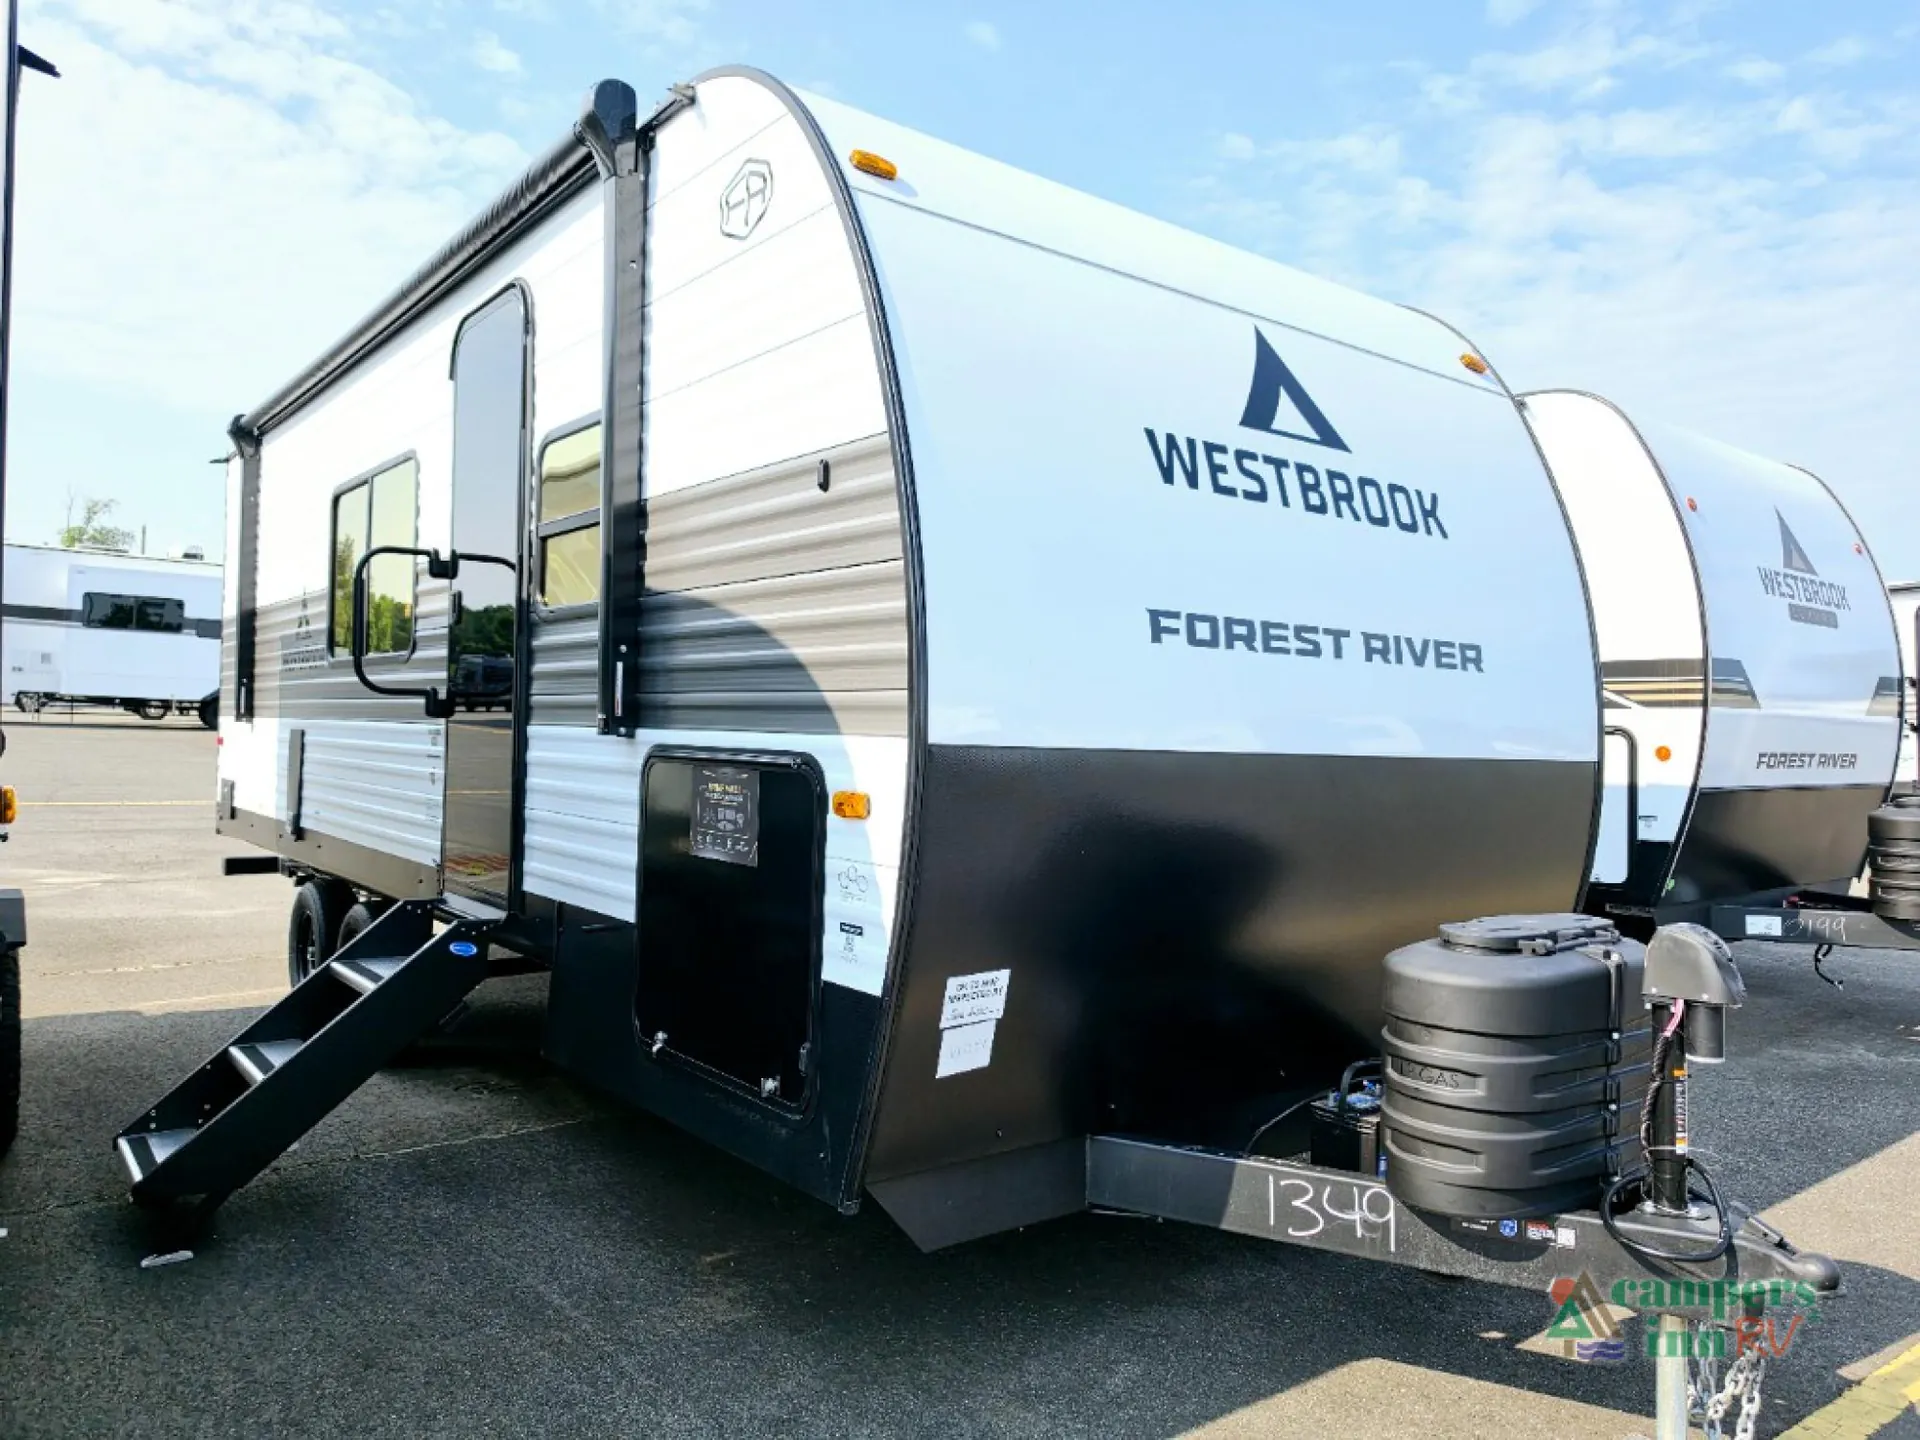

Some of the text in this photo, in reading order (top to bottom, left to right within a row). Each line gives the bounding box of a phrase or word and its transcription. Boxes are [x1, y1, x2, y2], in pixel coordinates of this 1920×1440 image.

[1144, 427, 1449, 539] WESTBROOK
[1757, 565, 1852, 612] WESTBROOK
[1145, 607, 1485, 674] FOREST RIVER
[1756, 752, 1857, 770] FOREST RIVER
[1418, 1065, 1461, 1090] GAS
[1268, 1173, 1396, 1253] 1349
